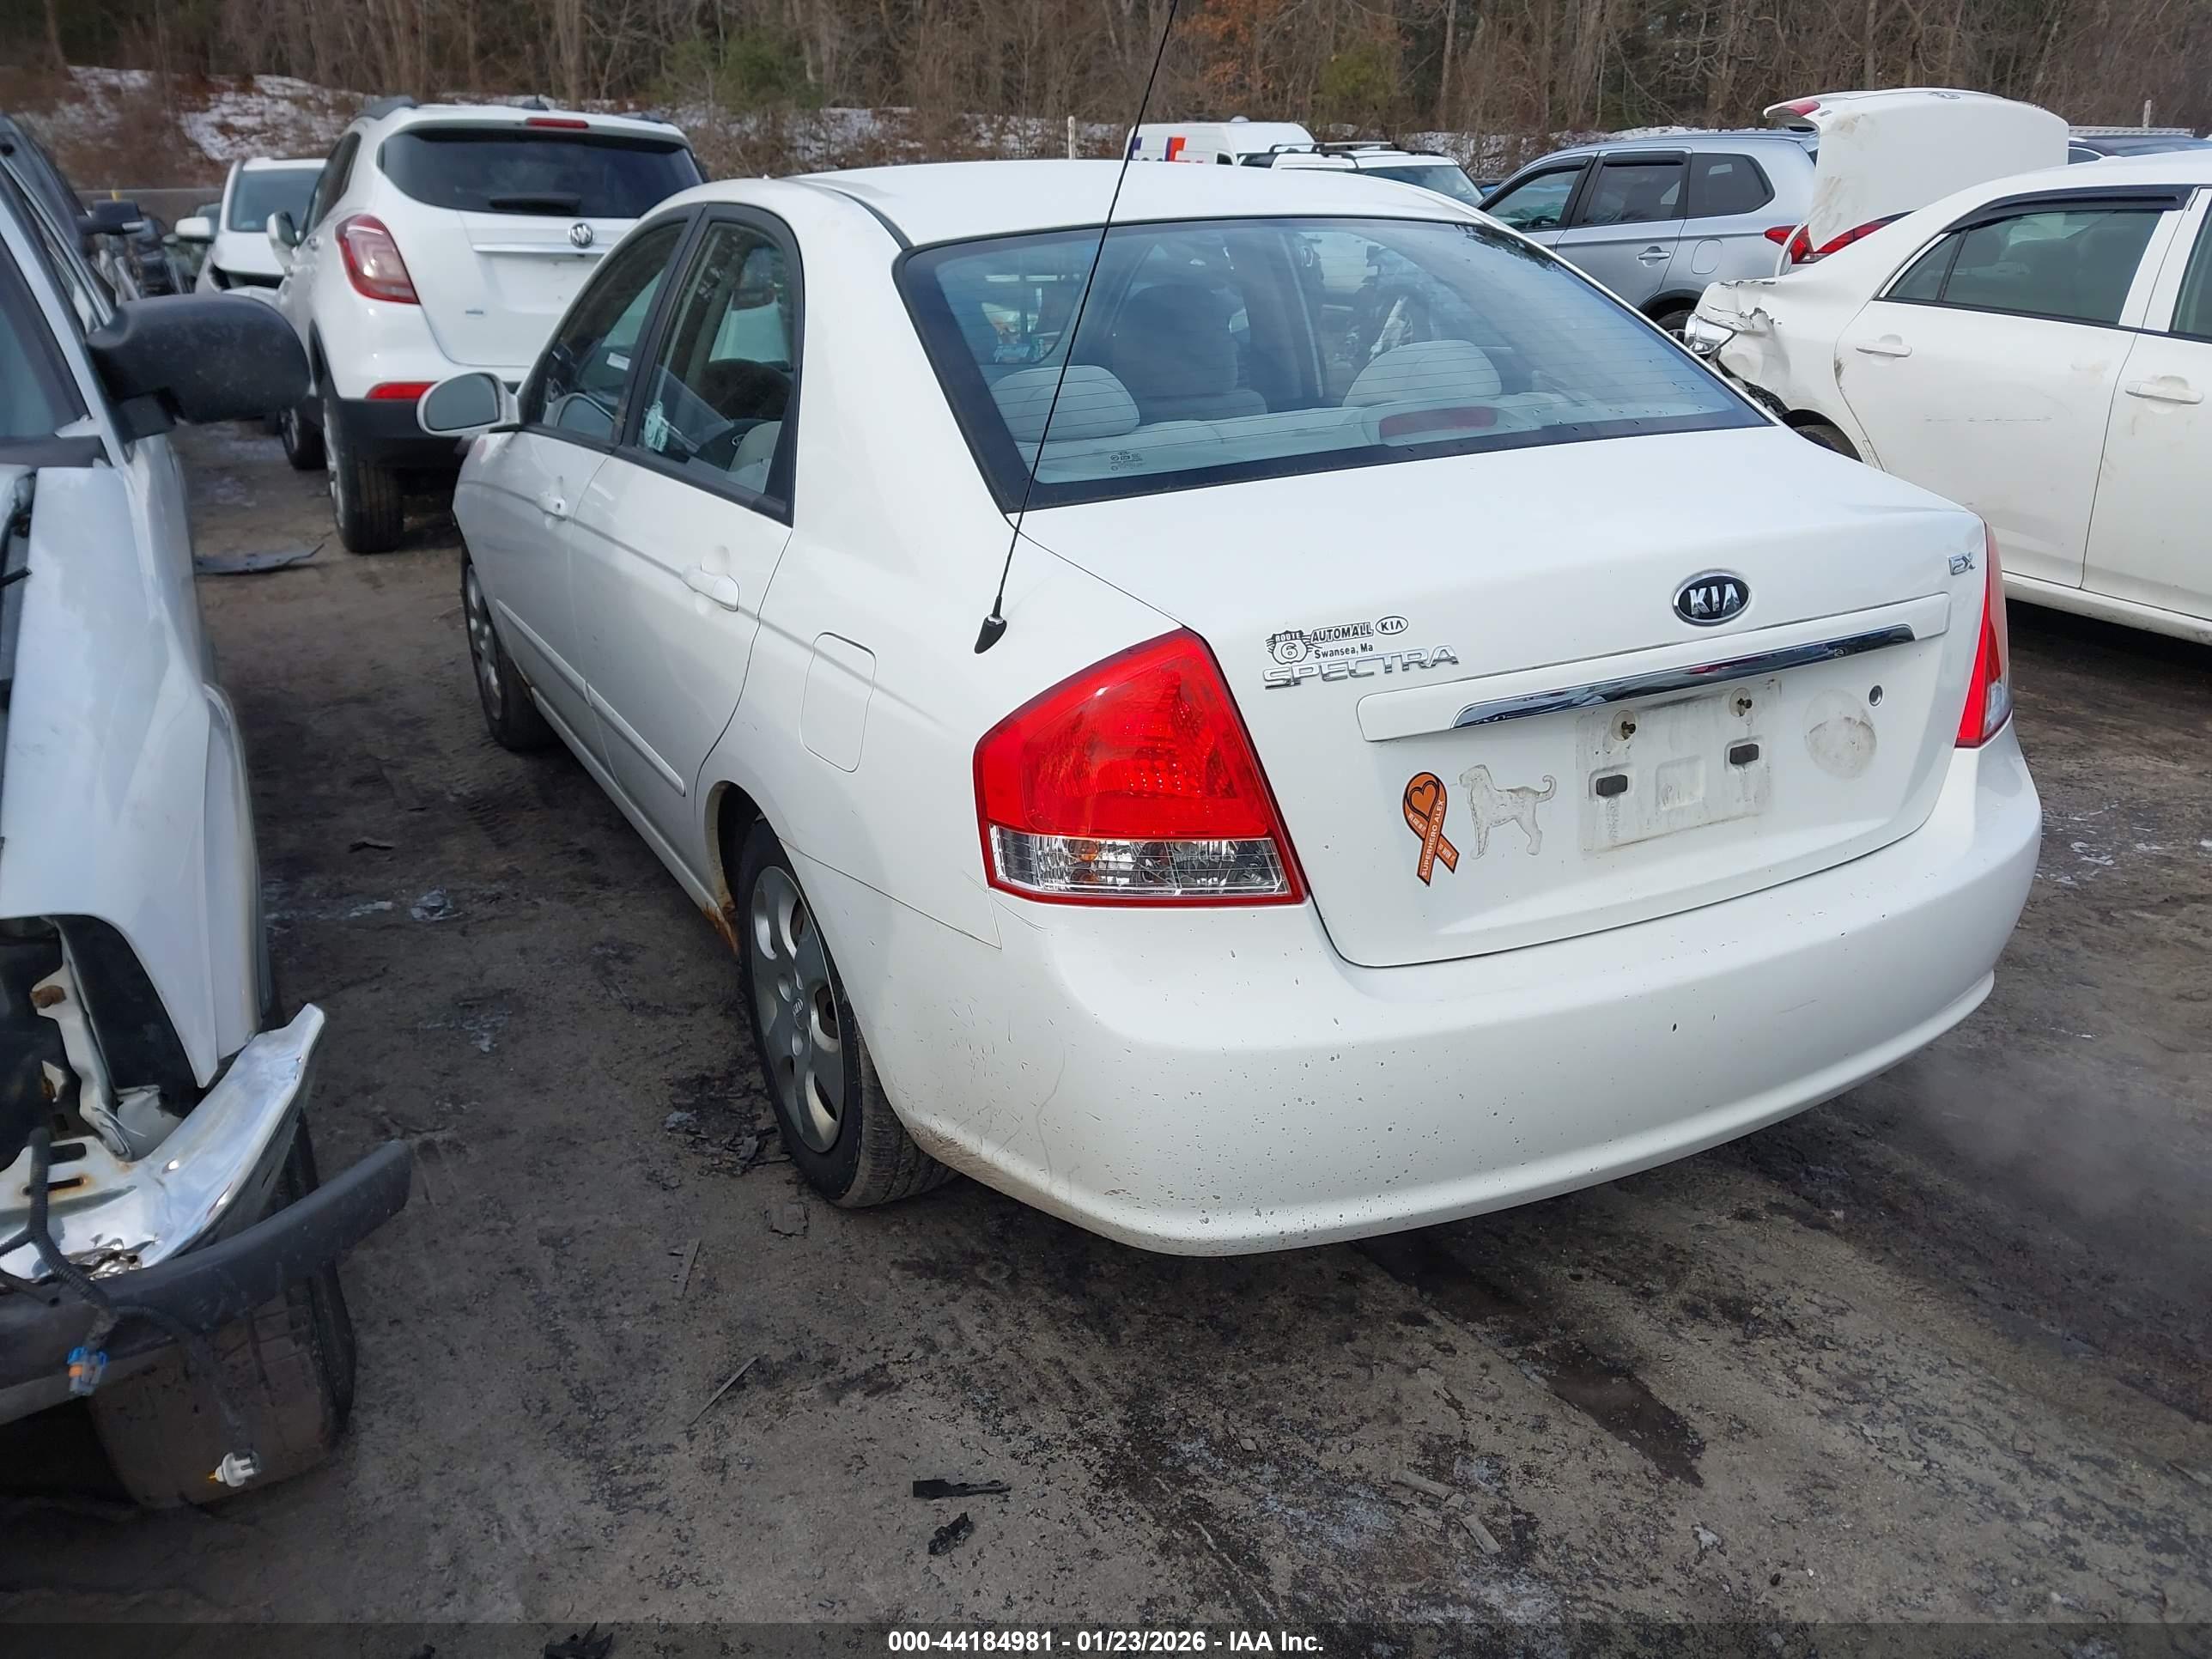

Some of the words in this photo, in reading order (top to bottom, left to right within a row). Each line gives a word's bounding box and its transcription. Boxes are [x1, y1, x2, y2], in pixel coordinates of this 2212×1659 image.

[1948, 552, 1977, 575] EX
[1688, 582, 1742, 616] KIA
[1311, 623, 1372, 642] AUTOMALL
[1380, 619, 1403, 633] KIA
[1275, 631, 1302, 643] ROUTE
[1280, 642, 1298, 659] 6
[1314, 646, 1359, 659] Swansea,
[1359, 642, 1374, 653] Ma
[1263, 645, 1460, 690] SPECTRA
[1421, 824, 1437, 876] SUPERHERO
[1434, 799, 1444, 823] ALEX
